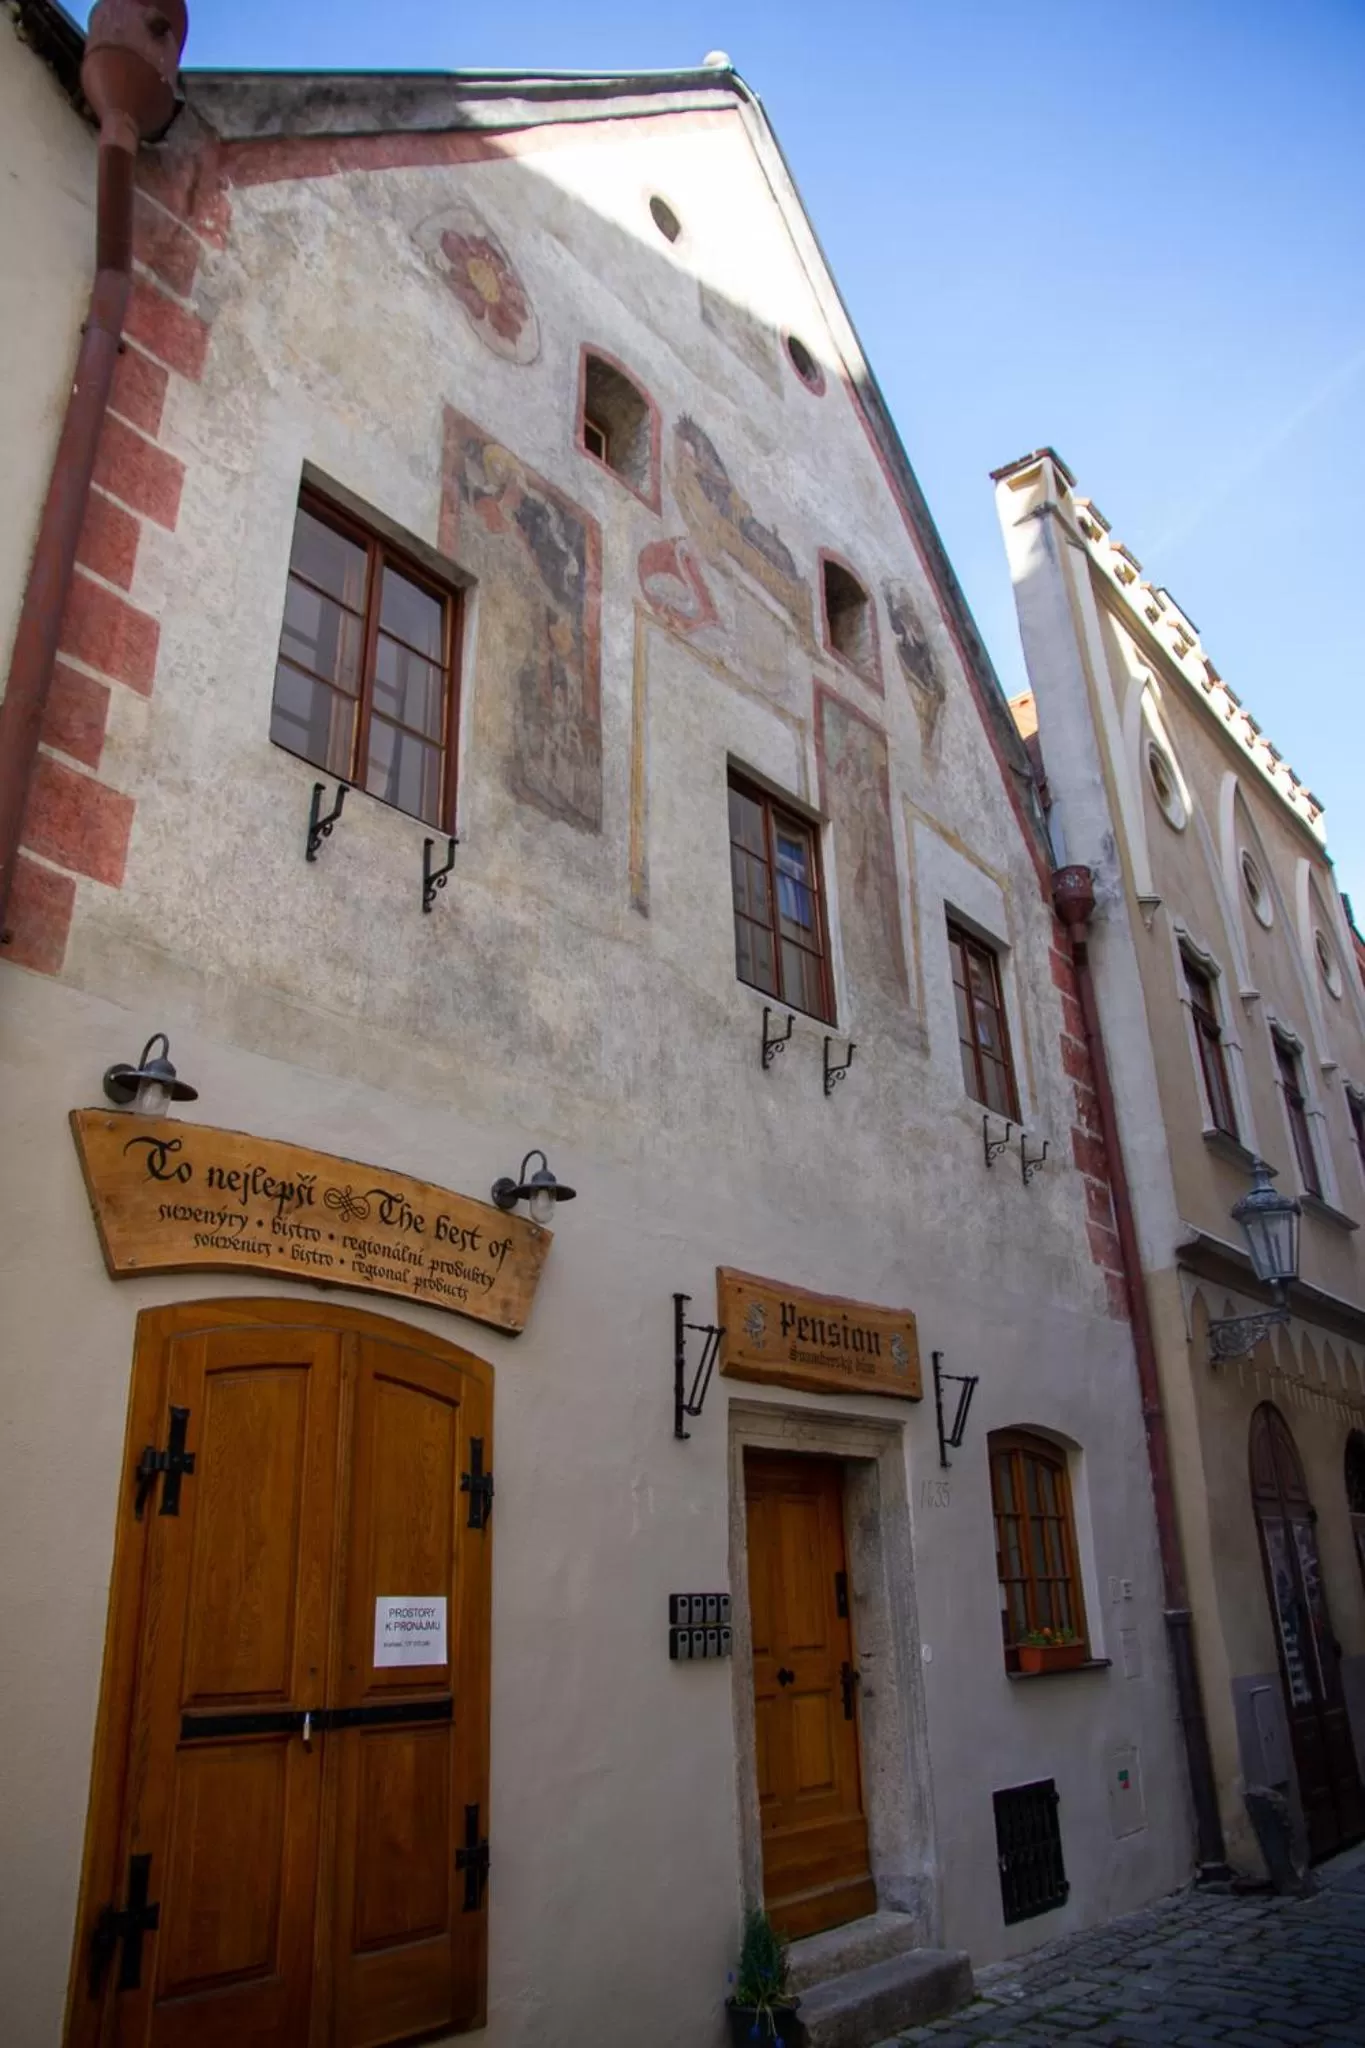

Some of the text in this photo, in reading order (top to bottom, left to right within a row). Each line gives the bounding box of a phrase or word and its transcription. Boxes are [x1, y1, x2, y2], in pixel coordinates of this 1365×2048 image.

[123, 1135, 515, 1272] To nejlepší The best of
[193, 1232, 468, 1304] souvenirs bistro regional products
[271, 1215, 321, 1242] bistro
[341, 1234, 425, 1268] regionální
[427, 1255, 497, 1295] produkty
[780, 1301, 882, 1357] Pension
[385, 1623, 393, 1631] K
[388, 1607, 436, 1618] PROSTORY
